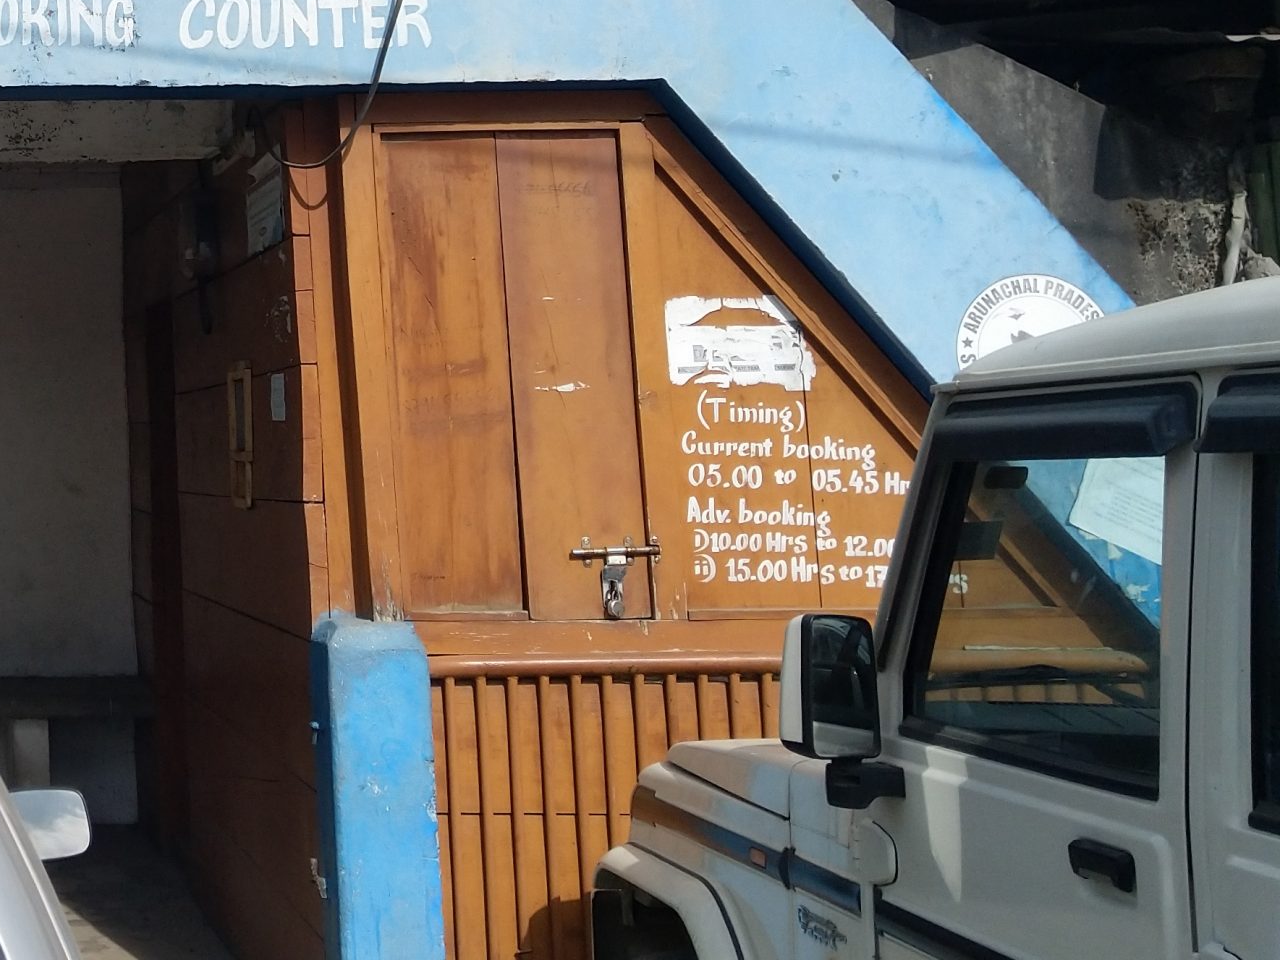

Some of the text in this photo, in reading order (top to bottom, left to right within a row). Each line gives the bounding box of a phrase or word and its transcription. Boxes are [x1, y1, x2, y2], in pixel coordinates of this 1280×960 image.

[963, 278, 1102, 335] ARUNACHAL PRADES
[697, 390, 805, 432] (Timing)
[681, 430, 876, 471] Current booking
[688, 463, 911, 496] 05.00 to 05.45 Hr
[687, 496, 832, 538] Adv. booking
[766, 531, 808, 554] Hrs
[816, 537, 837, 551] to
[693, 553, 717, 583] ii)
[724, 558, 788, 583] 15.00
[790, 556, 835, 585] Hrs
[839, 565, 863, 582] to
